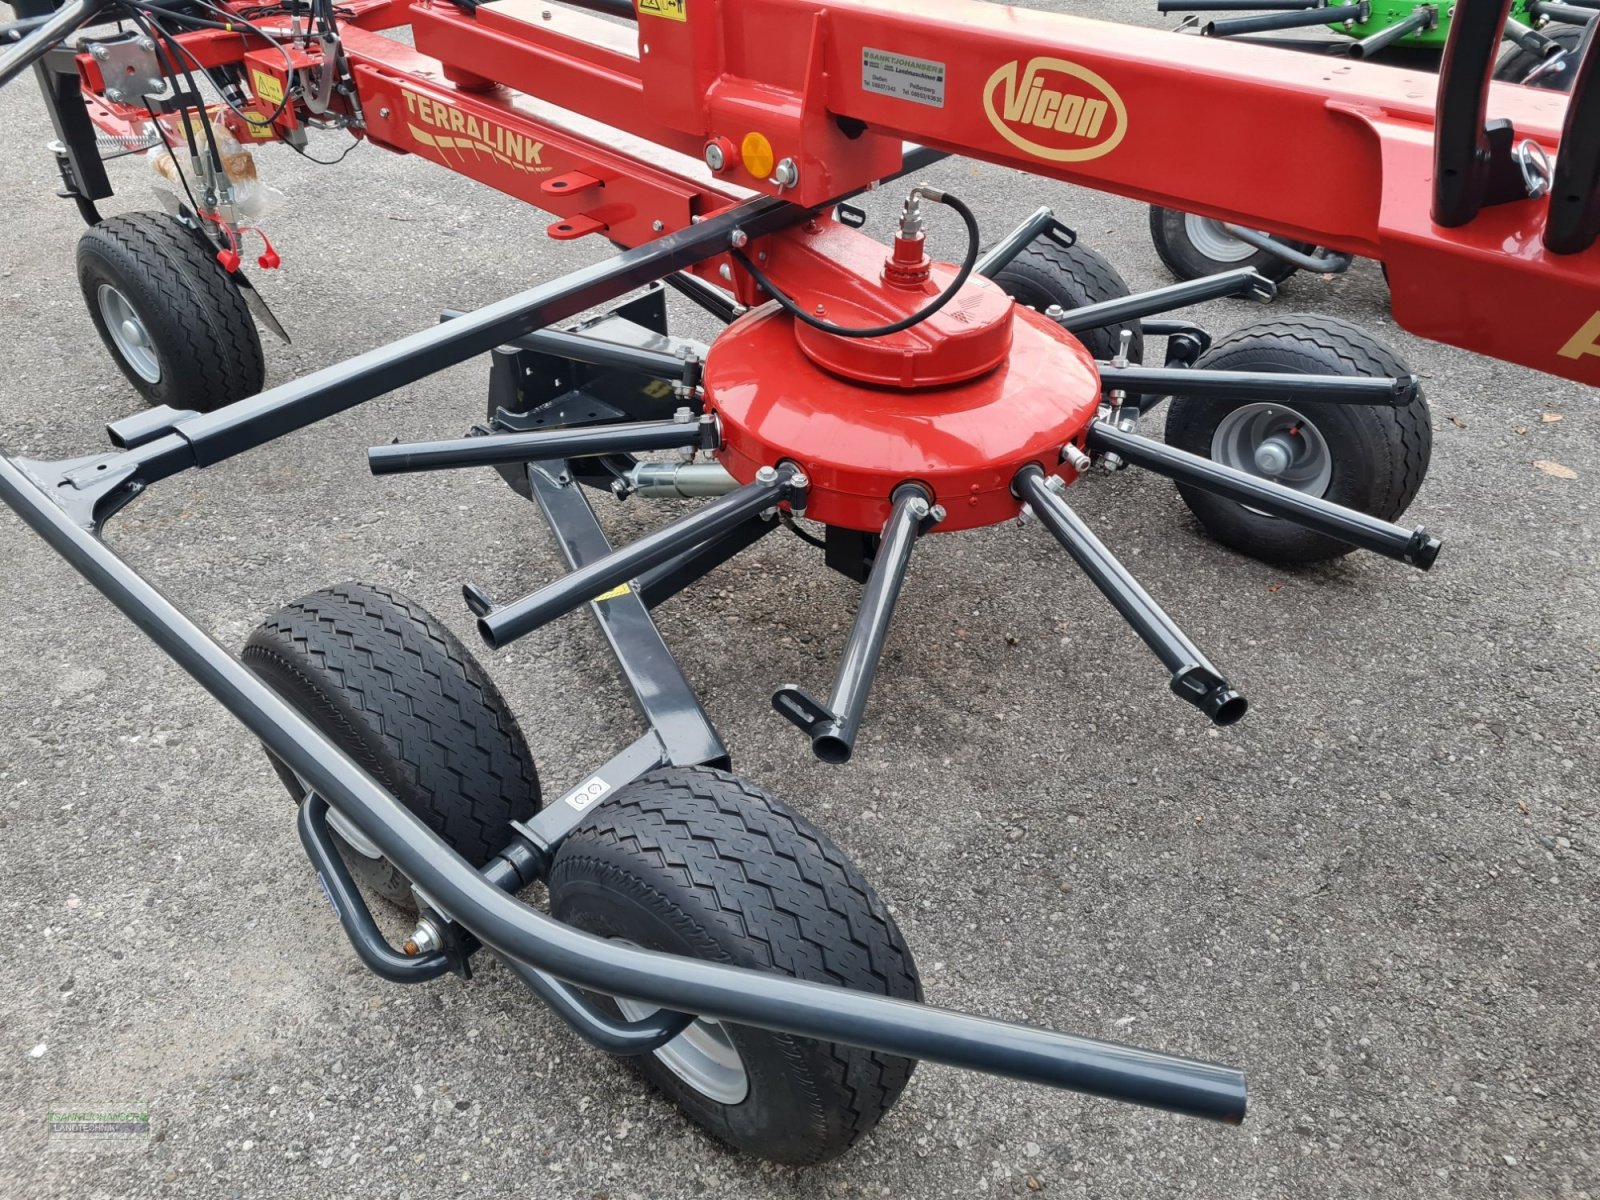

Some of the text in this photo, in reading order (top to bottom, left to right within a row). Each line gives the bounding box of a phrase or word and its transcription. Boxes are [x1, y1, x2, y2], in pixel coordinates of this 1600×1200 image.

[868, 51, 938, 73] SANKTJOHANSER
[1003, 60, 1108, 139] Vicon
[401, 88, 544, 165] TERRALINK
